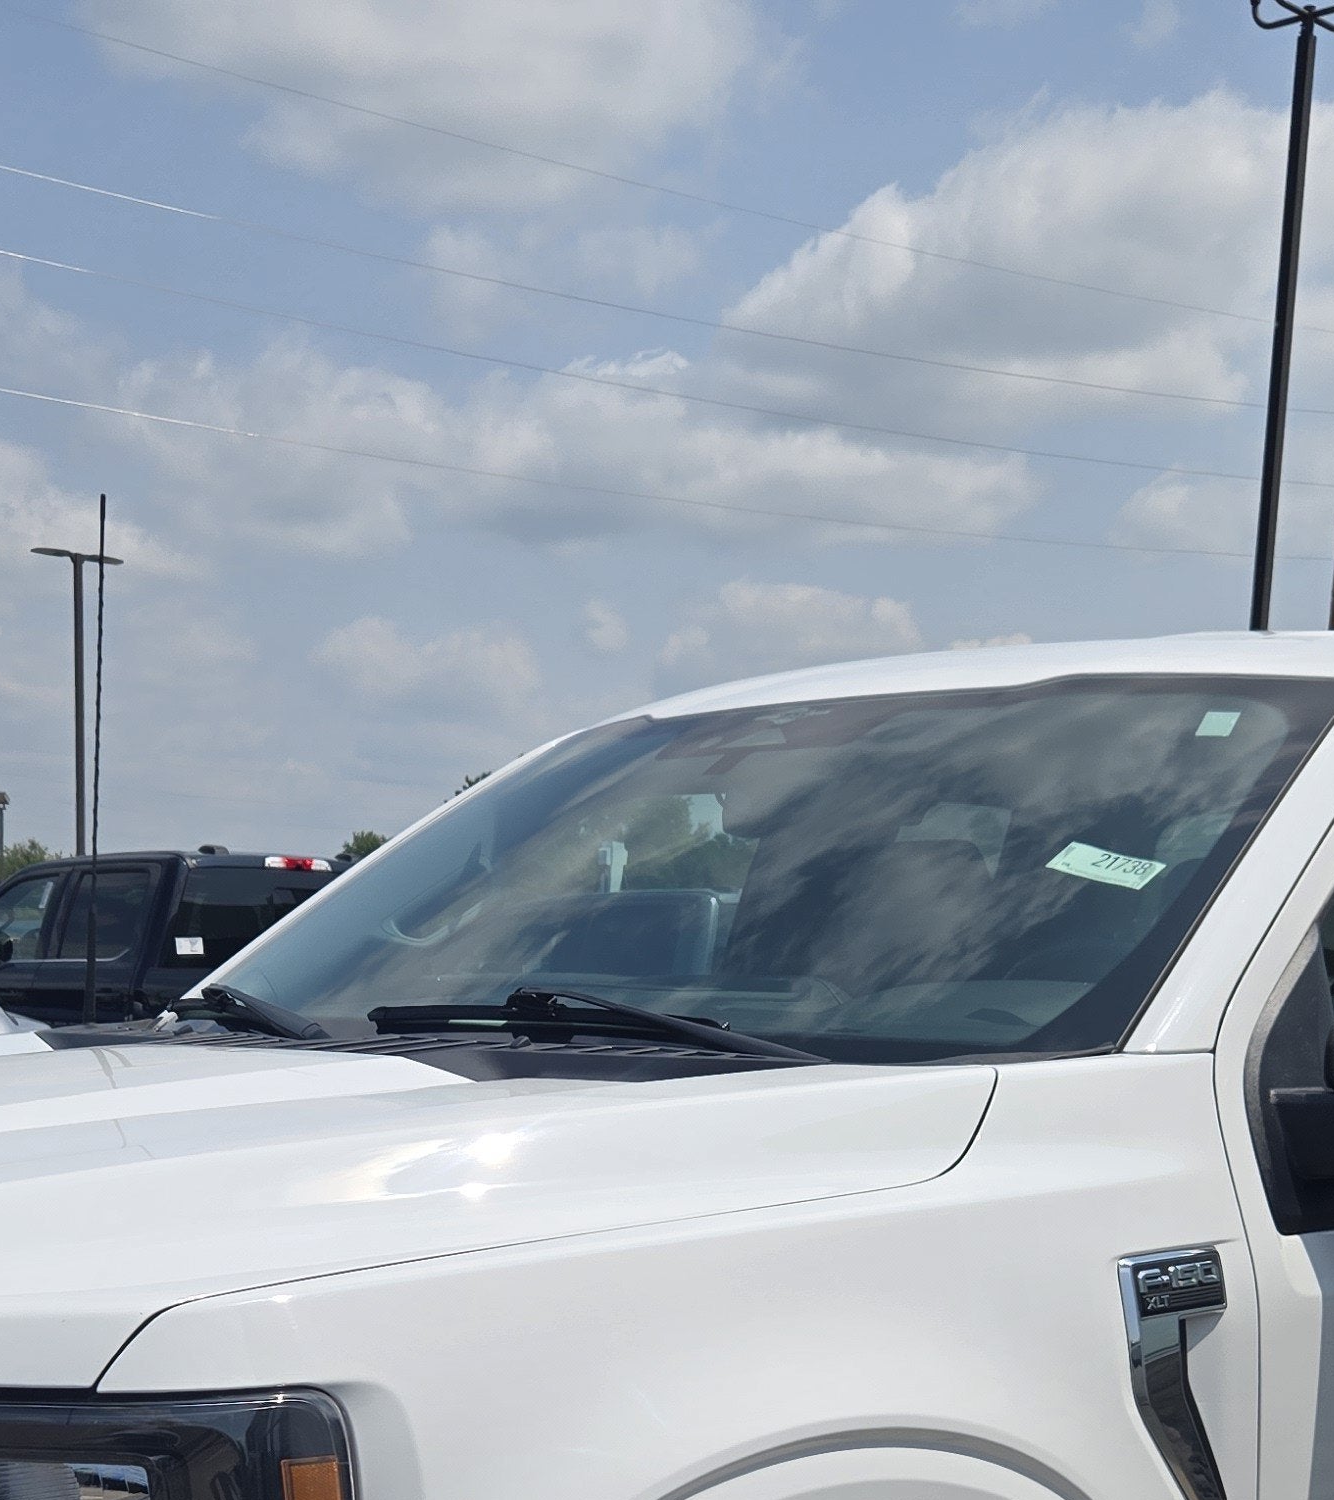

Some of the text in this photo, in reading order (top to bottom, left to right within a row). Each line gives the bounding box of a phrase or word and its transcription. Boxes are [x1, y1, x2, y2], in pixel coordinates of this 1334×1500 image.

[1091, 853, 1154, 876] 21738
[1137, 1260, 1220, 1294] F-150
[1146, 1294, 1170, 1310] XLT
